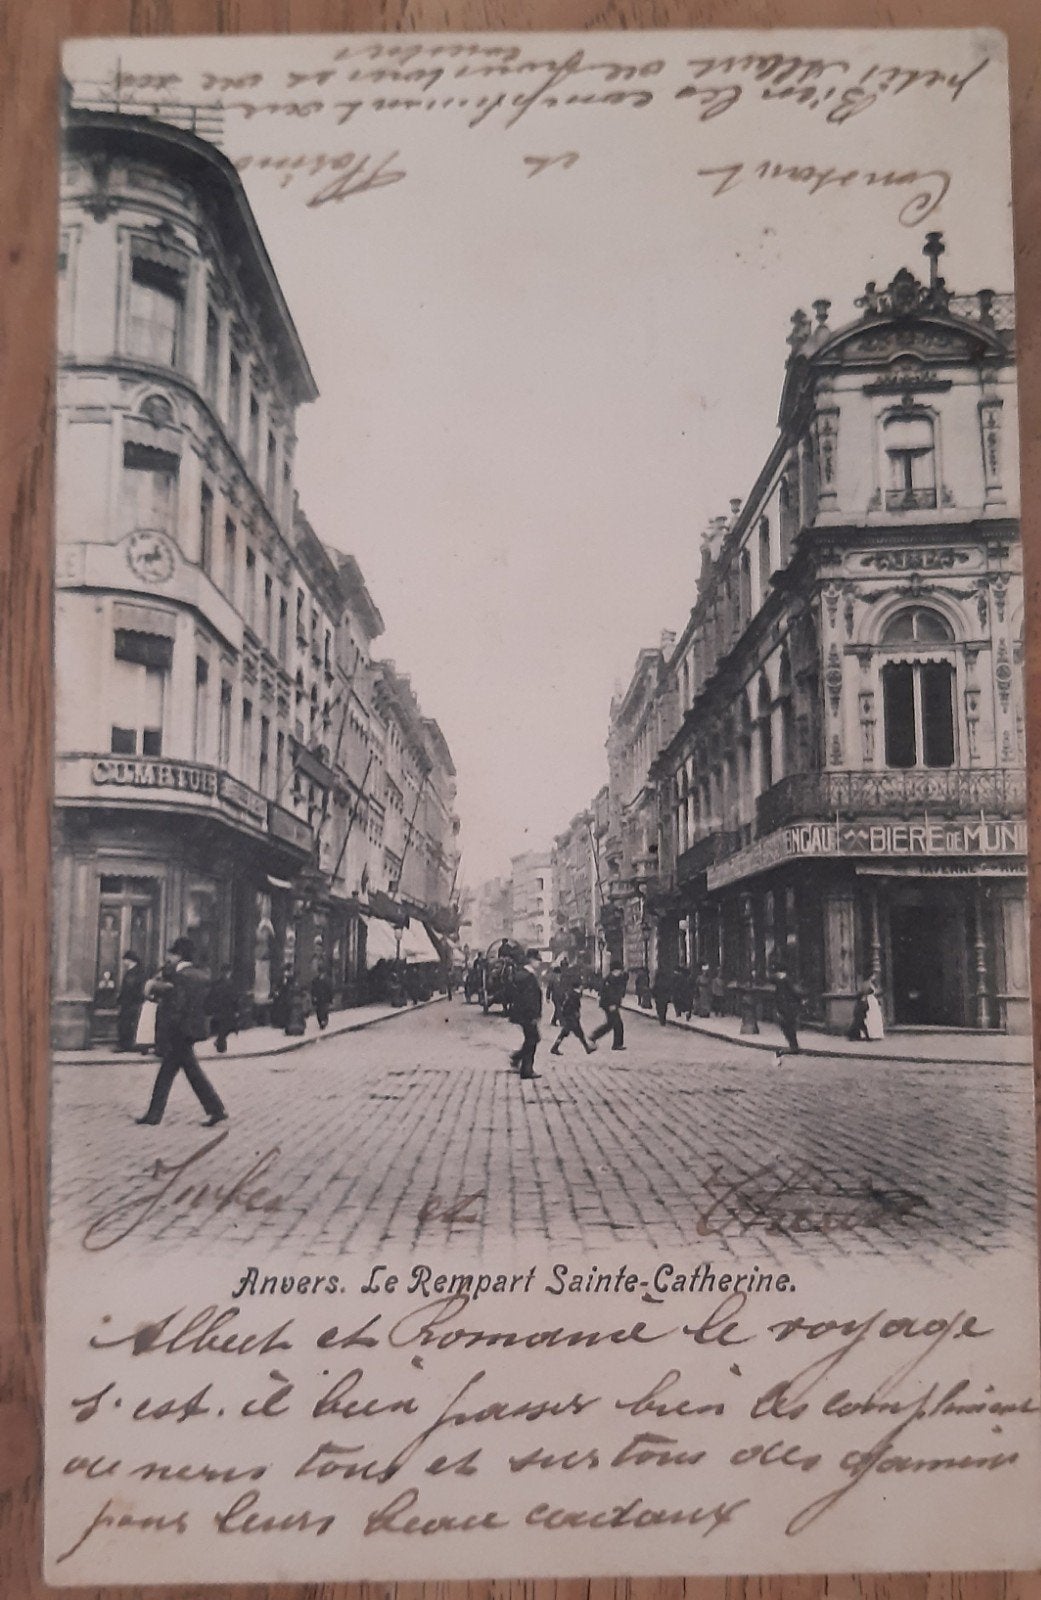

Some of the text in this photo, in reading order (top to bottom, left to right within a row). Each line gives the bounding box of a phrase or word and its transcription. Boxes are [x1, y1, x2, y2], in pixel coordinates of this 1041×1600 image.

[869, 825, 944, 851] BIERE
[232, 1260, 797, 1300] Anvers. Le Rempart Sainte-Catherine.
